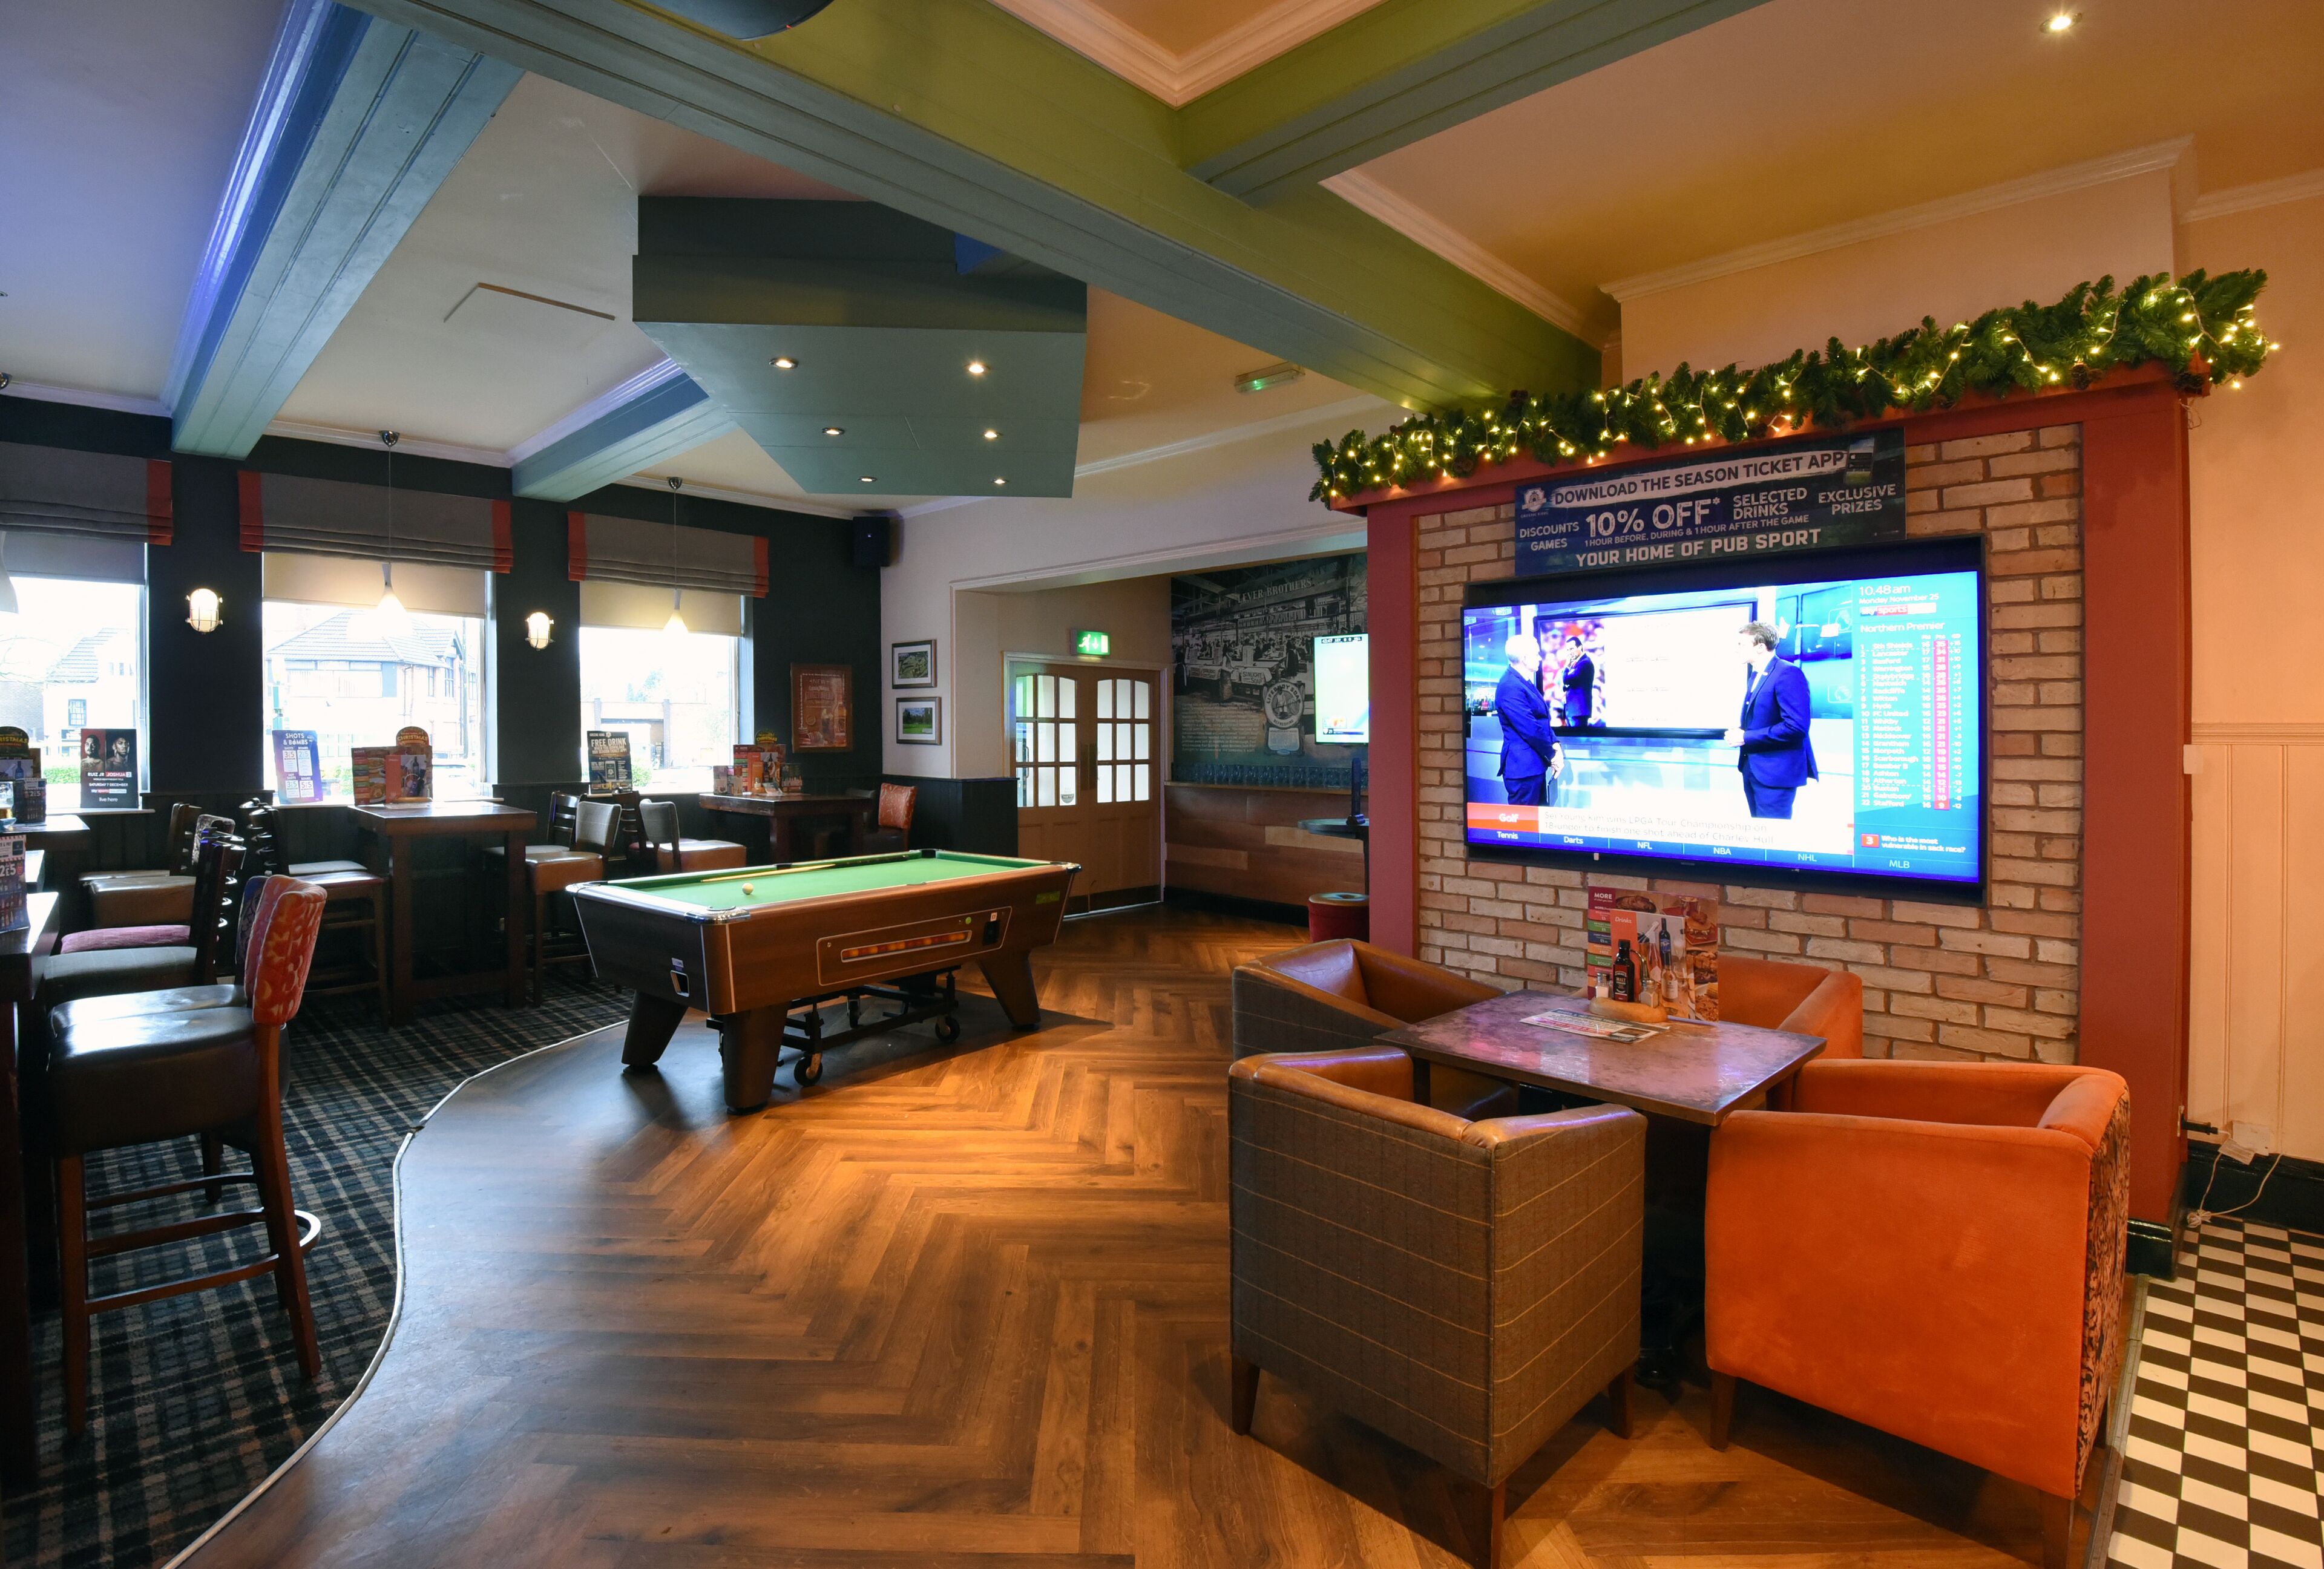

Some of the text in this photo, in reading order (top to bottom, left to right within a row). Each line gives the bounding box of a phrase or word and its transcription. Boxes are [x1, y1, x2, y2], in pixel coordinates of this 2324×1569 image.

[1554, 482, 1638, 505] DOWNLOAD
[1641, 476, 1671, 493] THE
[1675, 466, 1738, 487] SEASON
[1743, 456, 1803, 478] TICKET
[1808, 451, 1845, 470] APP
[1733, 487, 1807, 507] SELECTED
[1818, 484, 1896, 503] EXCLUSIVE
[1733, 503, 1788, 520] DRINKS
[1831, 499, 1882, 515] PRIZES
[1586, 508, 1645, 537] 10%
[1519, 522, 1580, 539] DISCOUNTS
[1615, 534, 1649, 544] BEFORE,
[1650, 529, 1684, 540] DURING
[1728, 520, 1758, 531] AFTER
[1761, 518, 1779, 528] THE
[1781, 514, 1809, 525] GAME
[1530, 538, 1568, 551] GAMES
[1576, 528, 1821, 567] YOUR HOME OF PUB SPORT
[1238, 577, 1312, 603] LEVER BROTHERS
[1859, 585, 1911, 596] 10.48 am
[1859, 596, 1888, 604] Monday
[1889, 594, 1927, 603] November
[1877, 605, 1908, 615] sports
[1860, 622, 1945, 633] Northern Premier
[591, 738, 626, 747] FREE DRINK
[1498, 813, 1519, 824] Golf
[1629, 816, 1653, 825] LPGA
[1656, 817, 1676, 826] Tour
[1681, 819, 1751, 831] Championship
[1497, 831, 1518, 840] Tennis
[1544, 822, 1581, 831] 18-under
[1597, 825, 1622, 833] finish
[1643, 828, 1664, 837] shot
[1667, 830, 1696, 839] ahead
[1563, 836, 1584, 845] Darts
[1637, 841, 1653, 850] NFL
[1866, 836, 1874, 845] 3
[1713, 847, 1732, 856] NBA
[1798, 853, 1817, 862] NHL
[1889, 859, 1910, 869] MLB
